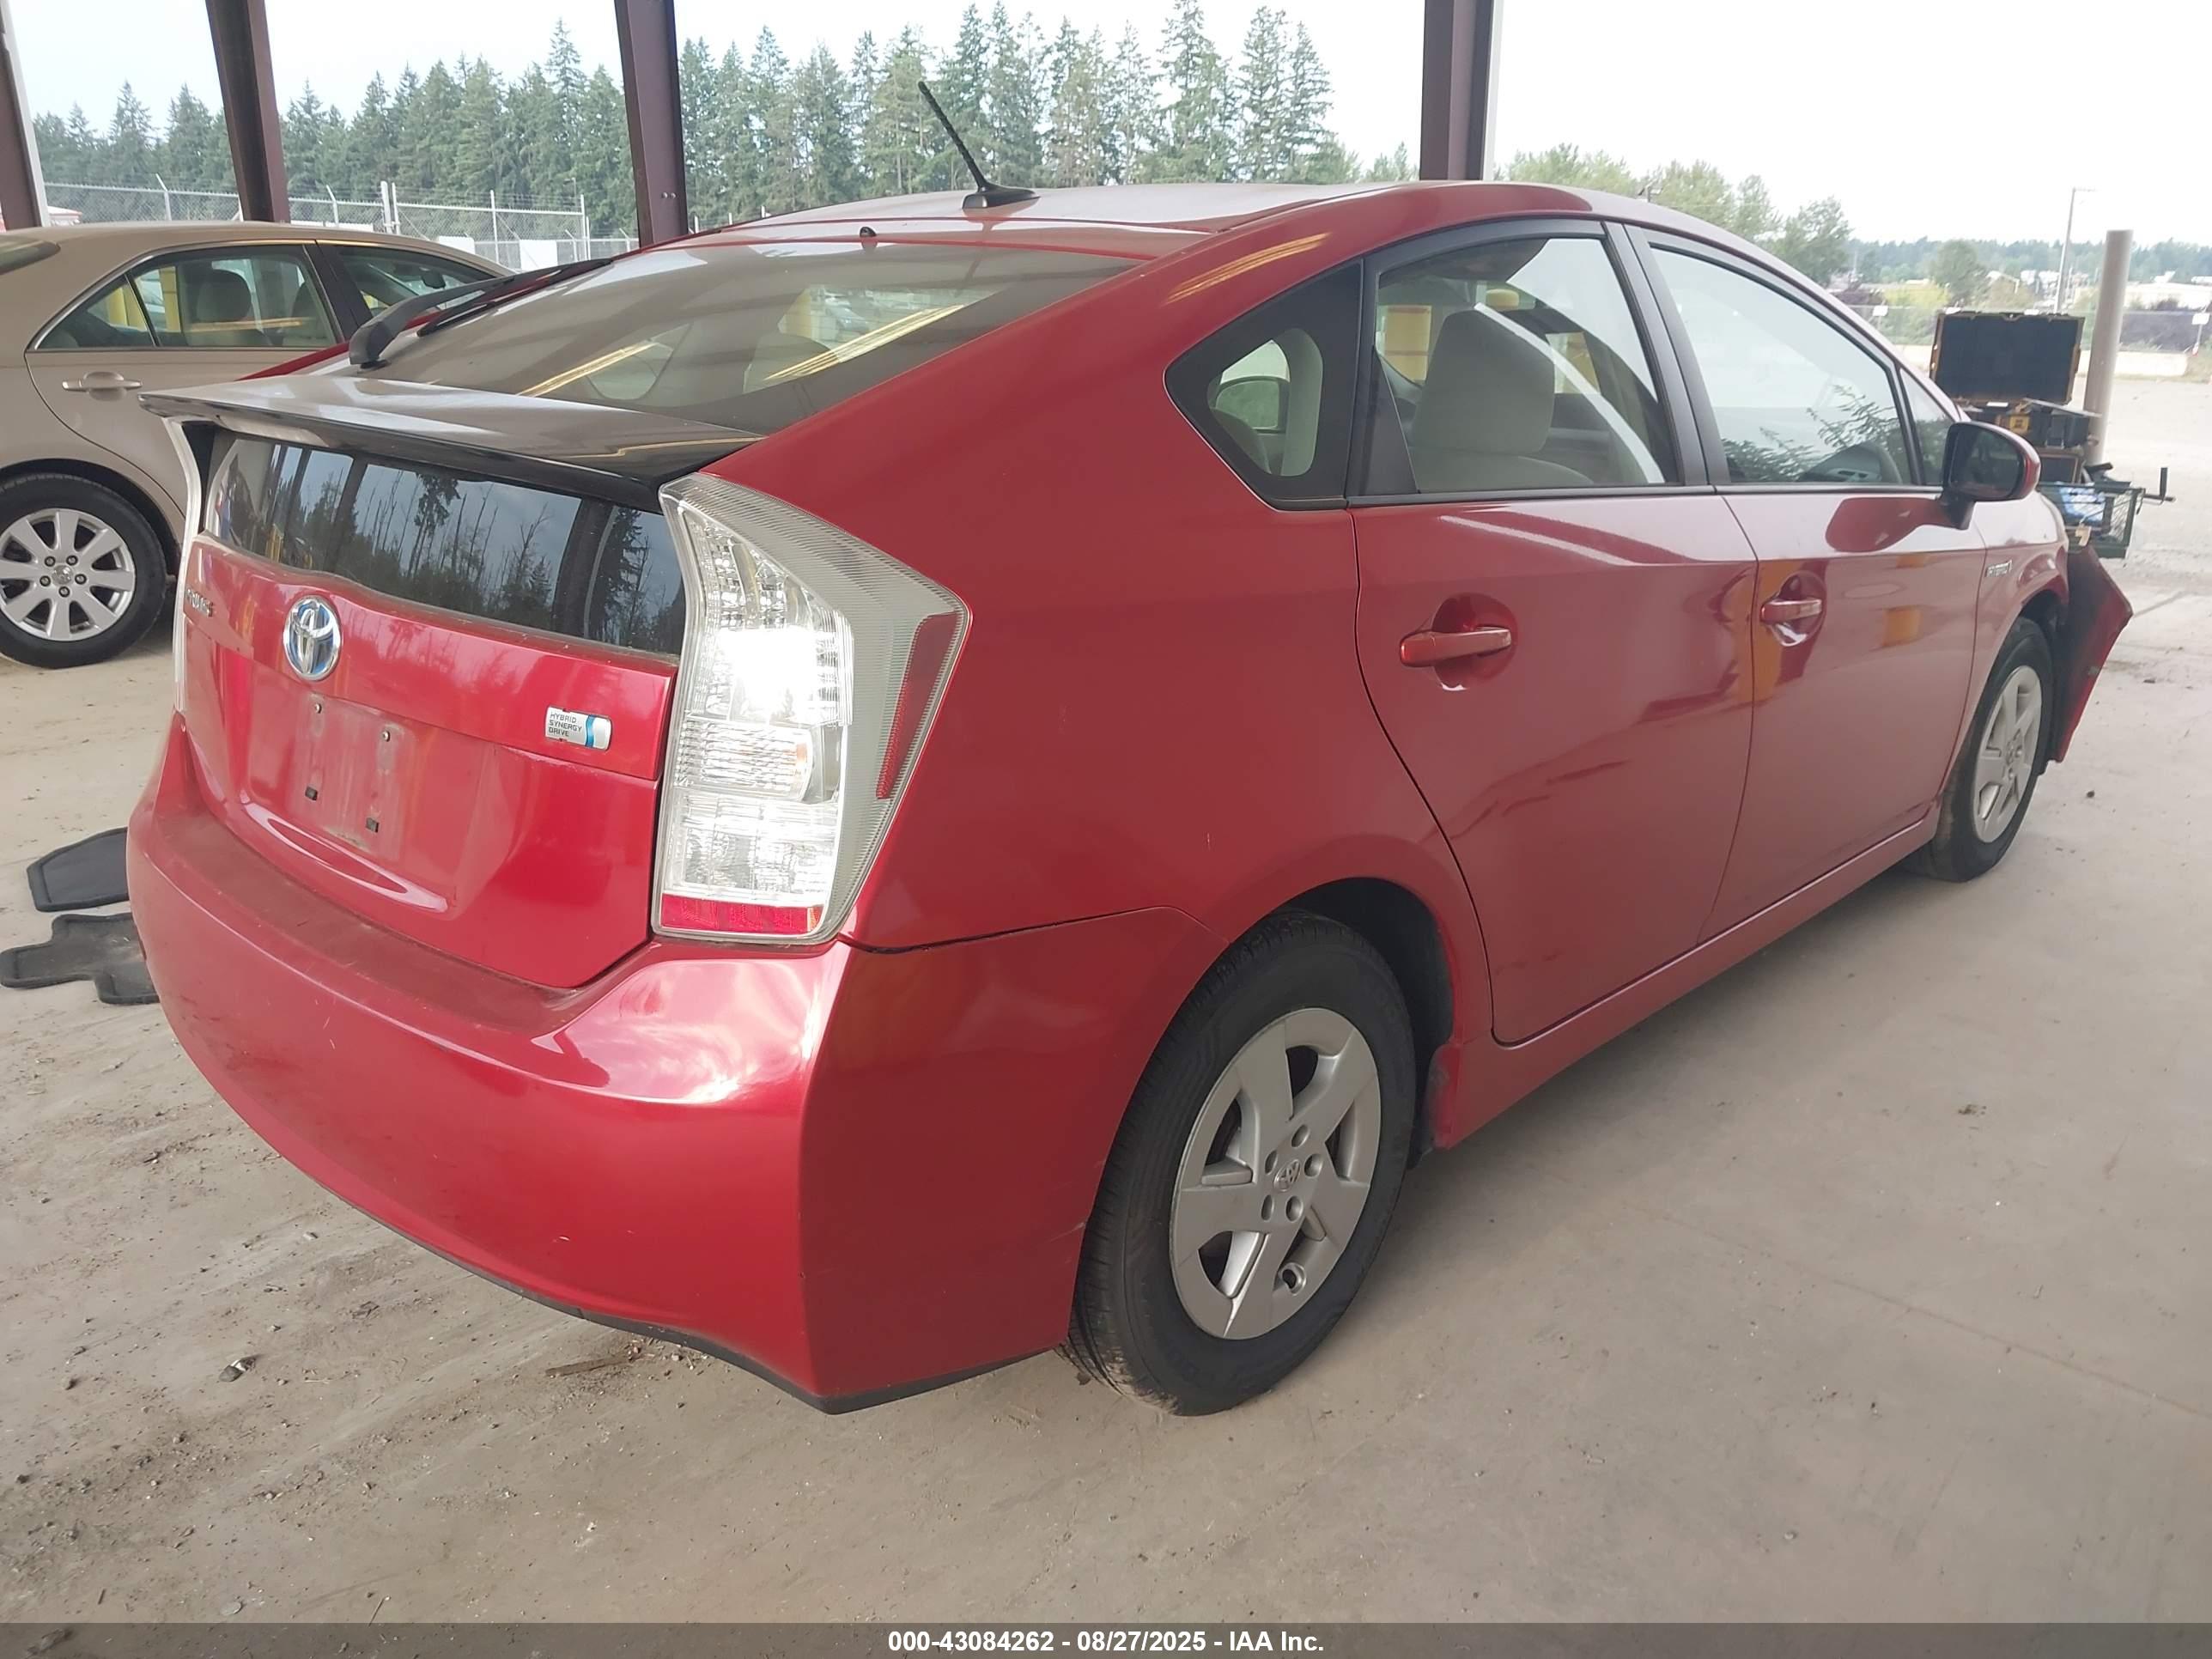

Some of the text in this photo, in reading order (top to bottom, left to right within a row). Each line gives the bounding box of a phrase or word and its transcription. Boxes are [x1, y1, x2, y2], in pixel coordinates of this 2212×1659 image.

[550, 711, 577, 724] HYBRID
[549, 720, 582, 732] SYNERGY
[549, 726, 569, 738] DRIVE
